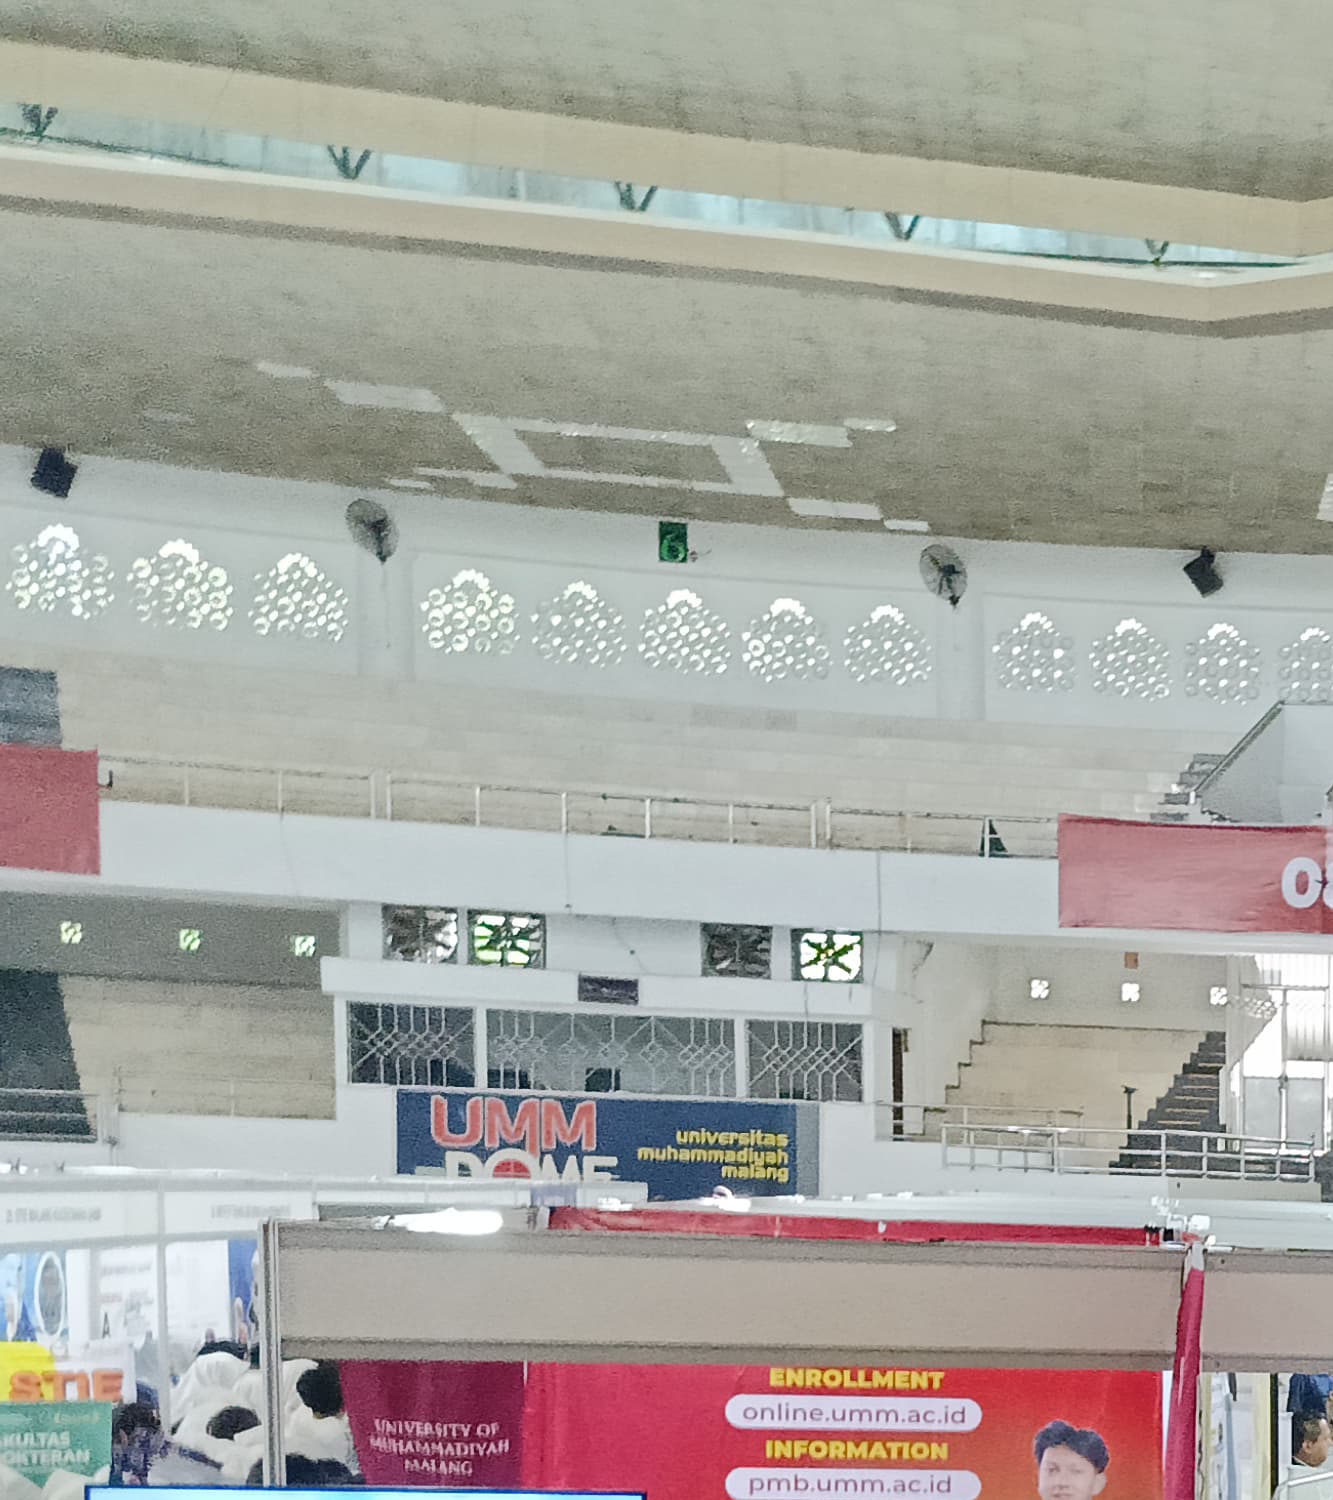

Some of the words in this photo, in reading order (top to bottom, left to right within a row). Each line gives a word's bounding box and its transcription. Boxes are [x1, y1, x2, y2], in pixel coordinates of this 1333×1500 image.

[431, 1094, 597, 1159] UMM
[675, 1128, 789, 1147] universitas
[444, 1148, 619, 1182] DOME
[637, 1145, 789, 1166] muhammadiyah
[721, 1164, 789, 1184] malang
[769, 1367, 945, 1391] ENROLLMENT
[743, 1402, 967, 1425] online.umm.ac.id
[374, 1418, 472, 1439] UNIVERSITY
[476, 1421, 501, 1438] OF
[369, 1434, 510, 1457] MUHAMMADIYAH
[766, 1439, 950, 1461] INFORMATION
[404, 1458, 474, 1477] MALANG
[749, 1473, 952, 1496] pmb.umm.ac.id
